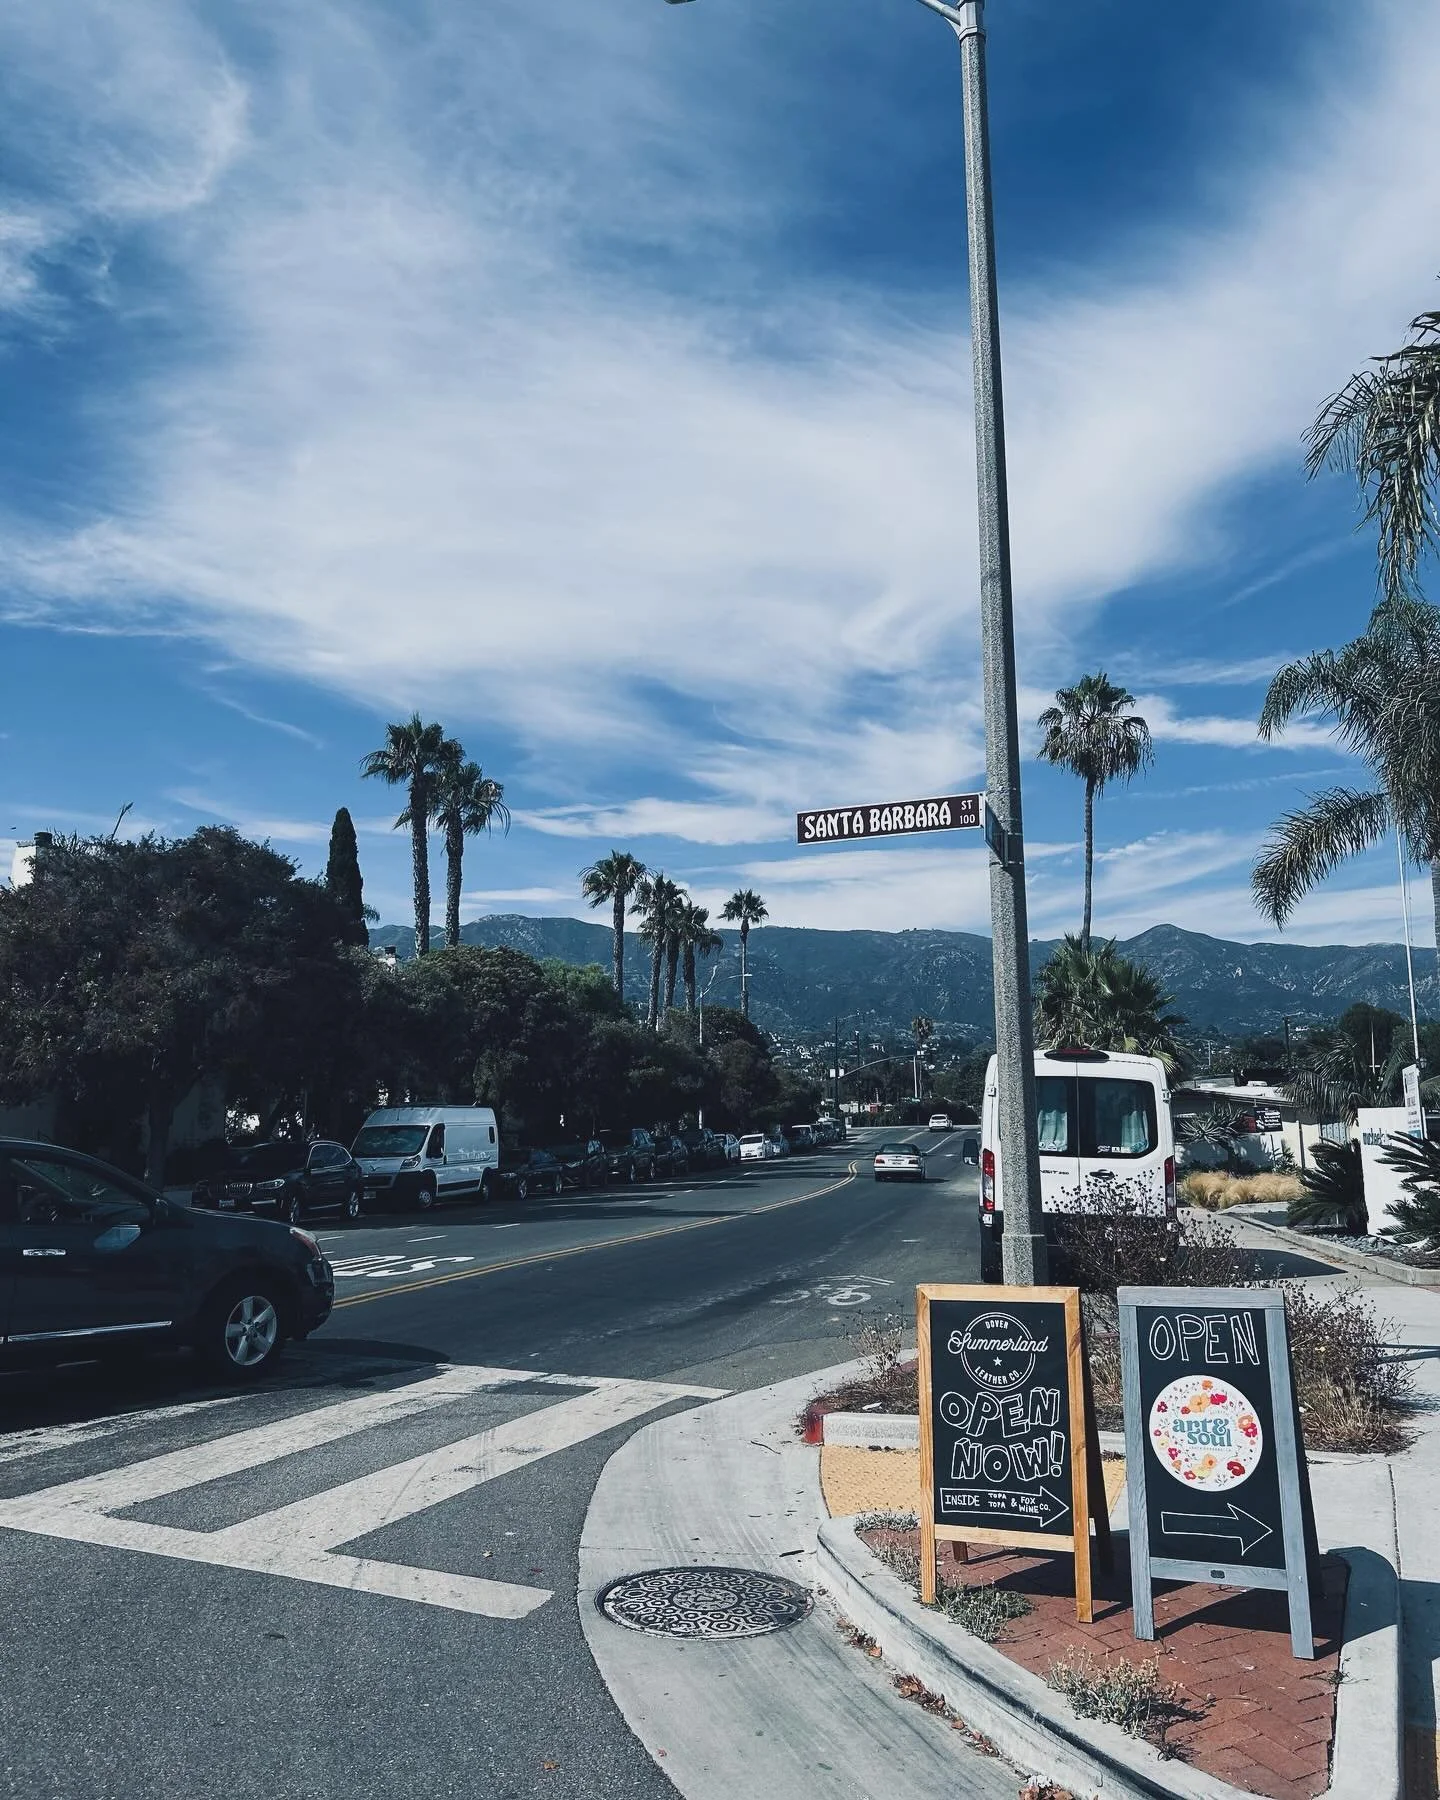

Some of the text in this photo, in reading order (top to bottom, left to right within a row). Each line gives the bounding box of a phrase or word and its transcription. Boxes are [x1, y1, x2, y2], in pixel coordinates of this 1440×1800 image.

[961, 799, 973, 811] ST
[804, 801, 951, 839] SANTA BARBARA
[960, 814, 976, 824] 100
[985, 1320, 1009, 1330] DOVER
[947, 1330, 1049, 1354] Summerland
[1149, 1312, 1260, 1365] OPEN
[974, 1366, 1023, 1385] LEATHER CO.
[940, 1387, 1060, 1438] OPEN
[1187, 1428, 1232, 1446] soul
[951, 1431, 1065, 1482] NOW!
[945, 1495, 980, 1506] INSIDE
[1010, 1498, 1018, 1507] &
[1020, 1496, 1036, 1505] FOX
